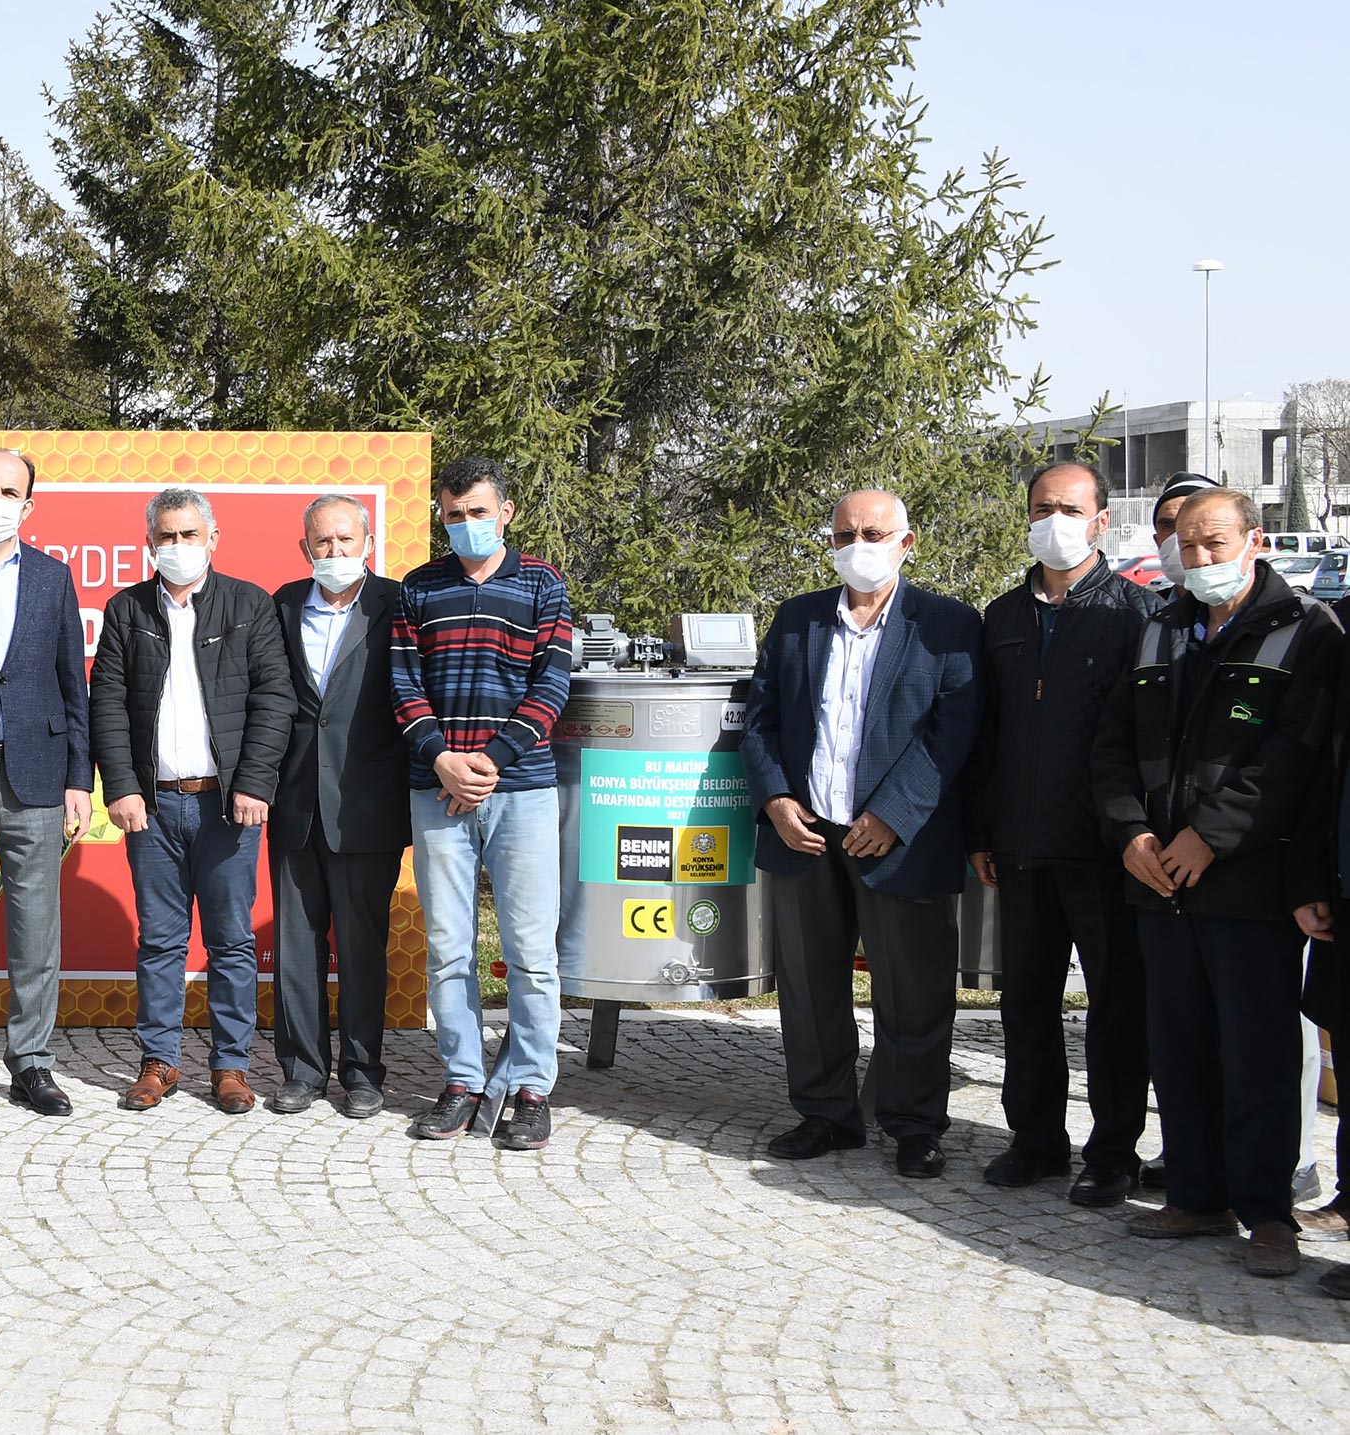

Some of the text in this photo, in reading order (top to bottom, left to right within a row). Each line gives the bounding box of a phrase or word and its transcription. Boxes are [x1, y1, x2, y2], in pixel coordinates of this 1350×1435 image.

[724, 711, 746, 724] 42.20
[644, 759, 709, 774] BU MAKİNE
[589, 776, 627, 789] KONYA
[630, 775, 700, 794] BÜYÜKŞEHİR
[591, 793, 660, 807] TARAFINDAN
[666, 811, 686, 820] 2021
[631, 905, 667, 933] CE
